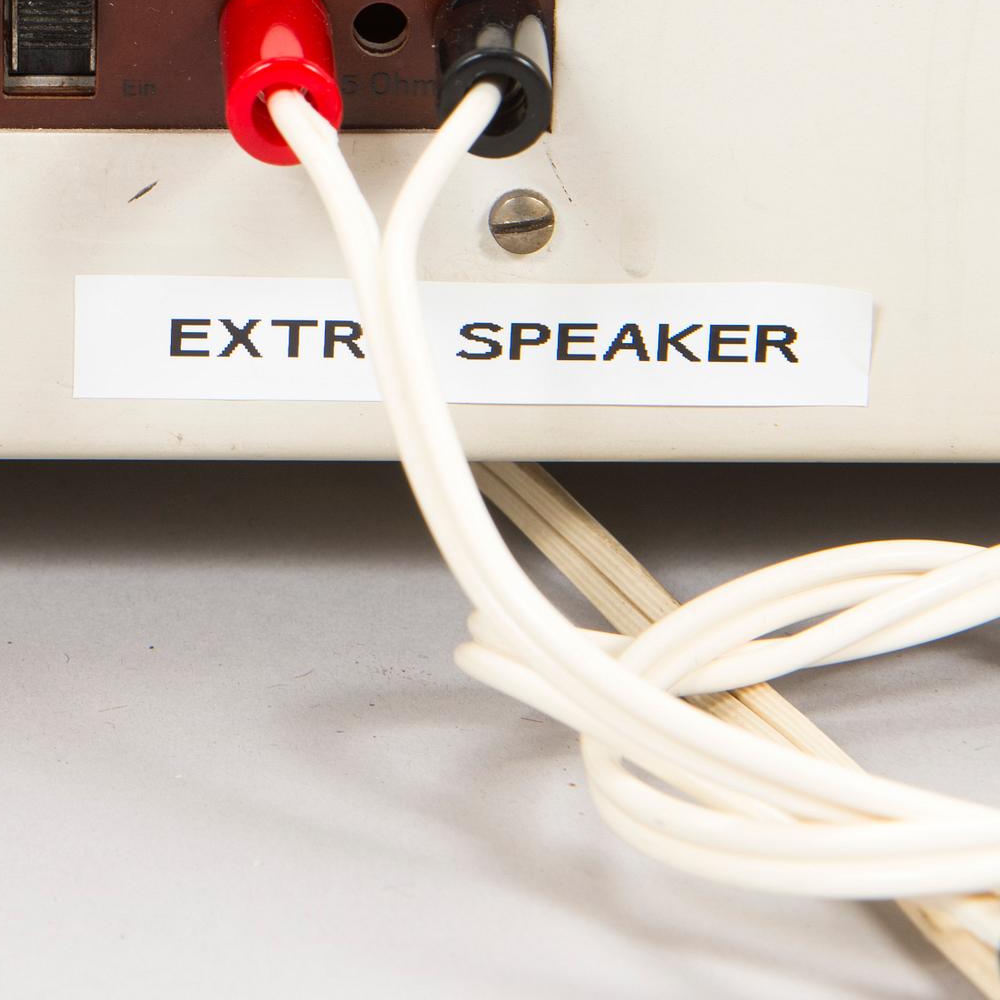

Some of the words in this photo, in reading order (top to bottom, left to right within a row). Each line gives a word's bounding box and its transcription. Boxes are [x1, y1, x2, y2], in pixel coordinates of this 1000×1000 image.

[371, 70, 437, 96] Ohm
[170, 318, 366, 360] EXTR
[456, 322, 798, 363] SPEAKER
